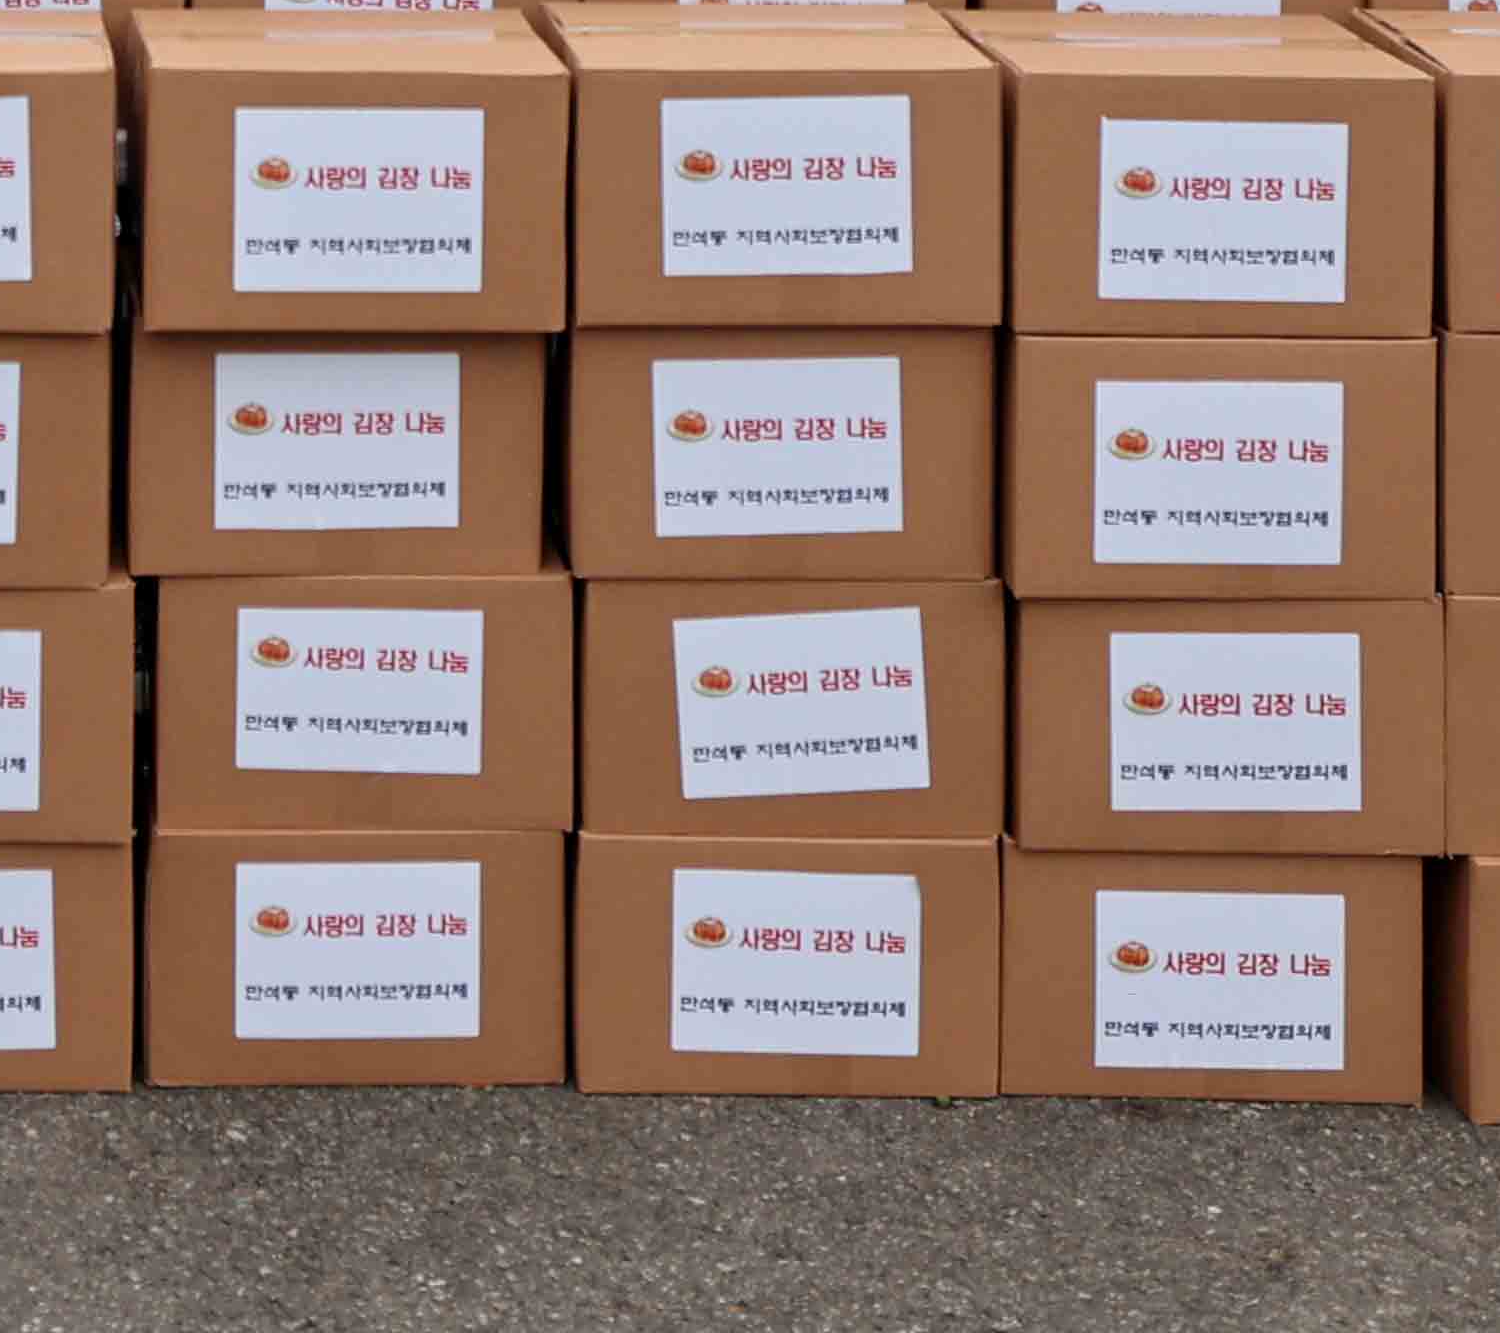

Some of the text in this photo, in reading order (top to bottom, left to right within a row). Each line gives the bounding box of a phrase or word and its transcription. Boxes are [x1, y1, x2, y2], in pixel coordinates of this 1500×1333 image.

[302, 165, 473, 192] 사랑의 김장 나눔
[1168, 175, 1337, 203] 사랑의 김장 나눔
[719, 415, 889, 444] 사랑의 김장 나눔
[1177, 691, 1348, 719] 사랑의 김장 나눔
[737, 926, 907, 955] 사랑의 김장 나눔
